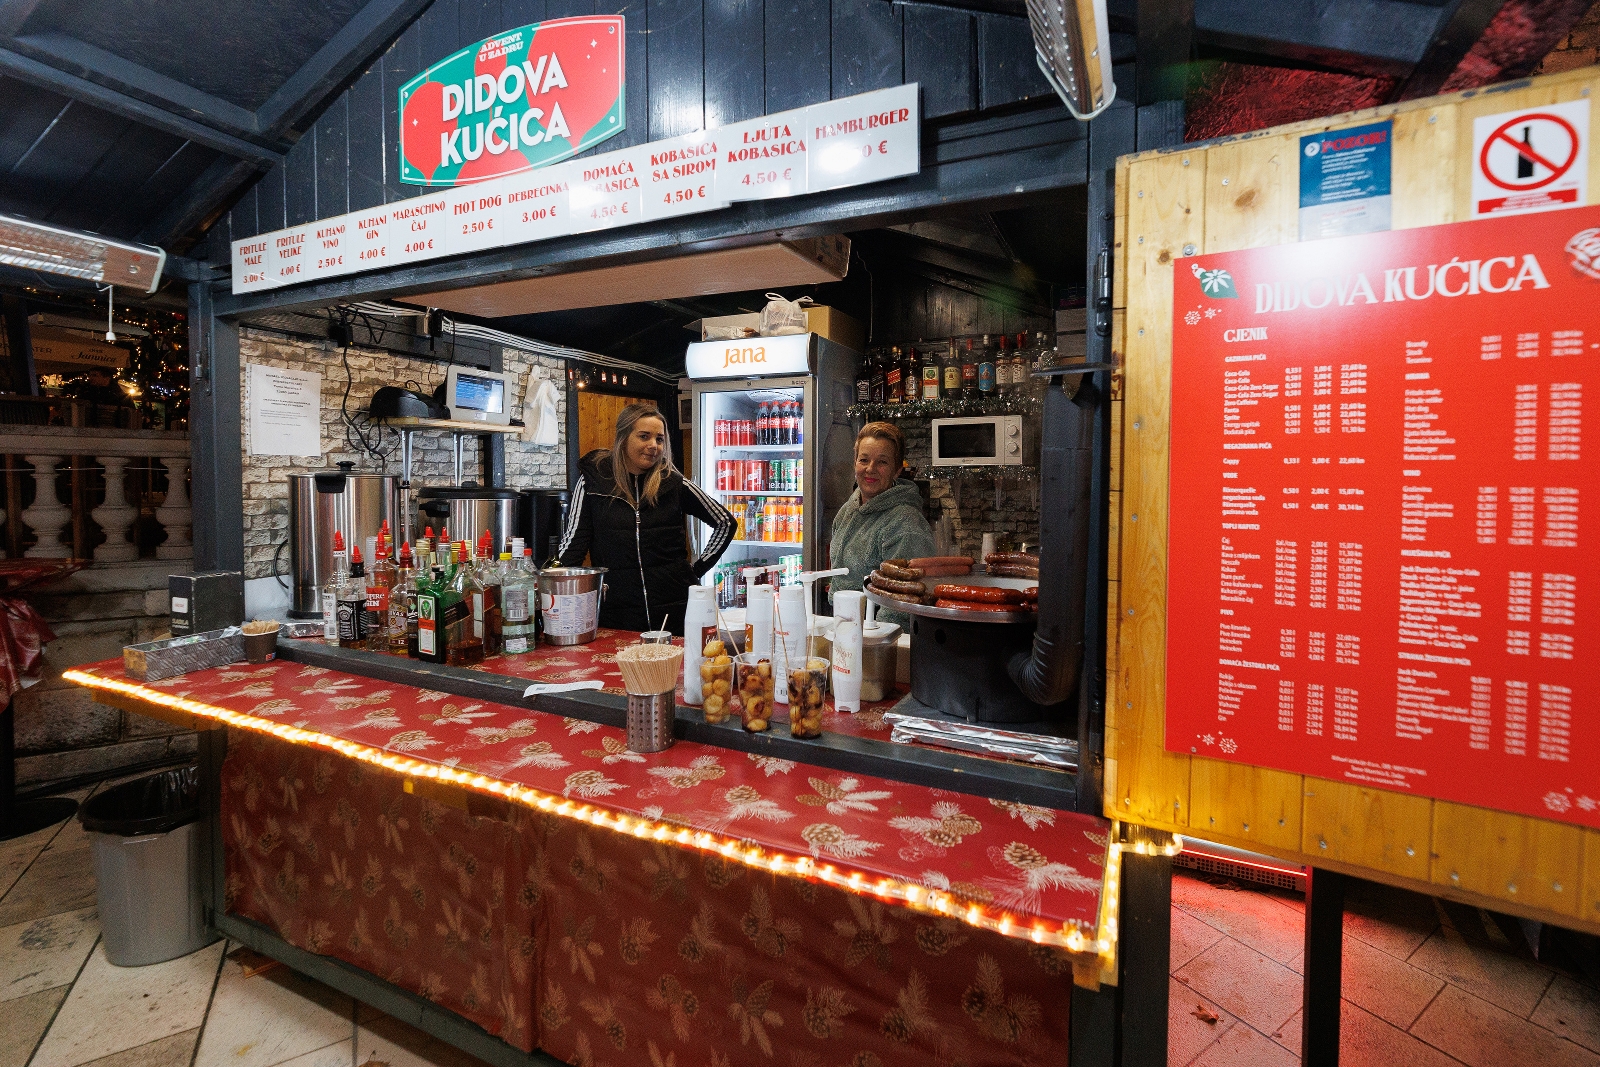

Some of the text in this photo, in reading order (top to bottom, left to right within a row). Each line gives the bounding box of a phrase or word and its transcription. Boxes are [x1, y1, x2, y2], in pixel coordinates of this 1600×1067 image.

[480, 32, 522, 52] ADVENT
[479, 41, 524, 62] U ZADRU
[442, 52, 568, 122] DIDOVA
[815, 108, 909, 140] HAMBURGER
[441, 101, 571, 168] KUĆICA
[743, 125, 792, 143] LJUTA
[651, 142, 717, 166] KOBASICA
[728, 139, 806, 162] KOBASICA
[878, 140, 888, 154] €
[584, 160, 634, 182] DOMAĆA
[652, 158, 716, 182] SA SIROM
[742, 168, 792, 186] 4,50 €
[508, 182, 569, 203] DEBRECINKA
[664, 186, 705, 205] 4,50 €
[393, 201, 445, 220] MARASCHINO
[454, 195, 502, 215] HOT DOG
[550, 206, 556, 216] €
[622, 202, 628, 213] €
[359, 215, 386, 229] KUHANI
[411, 220, 426, 232] ČAJ
[488, 219, 493, 228] €
[317, 225, 345, 238] KUHANO
[366, 230, 378, 240] GIN
[276, 234, 305, 247] FRITULE
[323, 238, 338, 249] VINO
[428, 239, 433, 248] €
[240, 242, 266, 255] FRITULE
[279, 246, 302, 259] VELIKE
[381, 247, 386, 256] €
[245, 255, 262, 266] MALE
[338, 256, 343, 264] €
[296, 264, 301, 272] €
[1255, 272, 1378, 314] DIDOVA
[1383, 254, 1551, 303] KUĆICA
[1224, 327, 1268, 343] CJENIK
